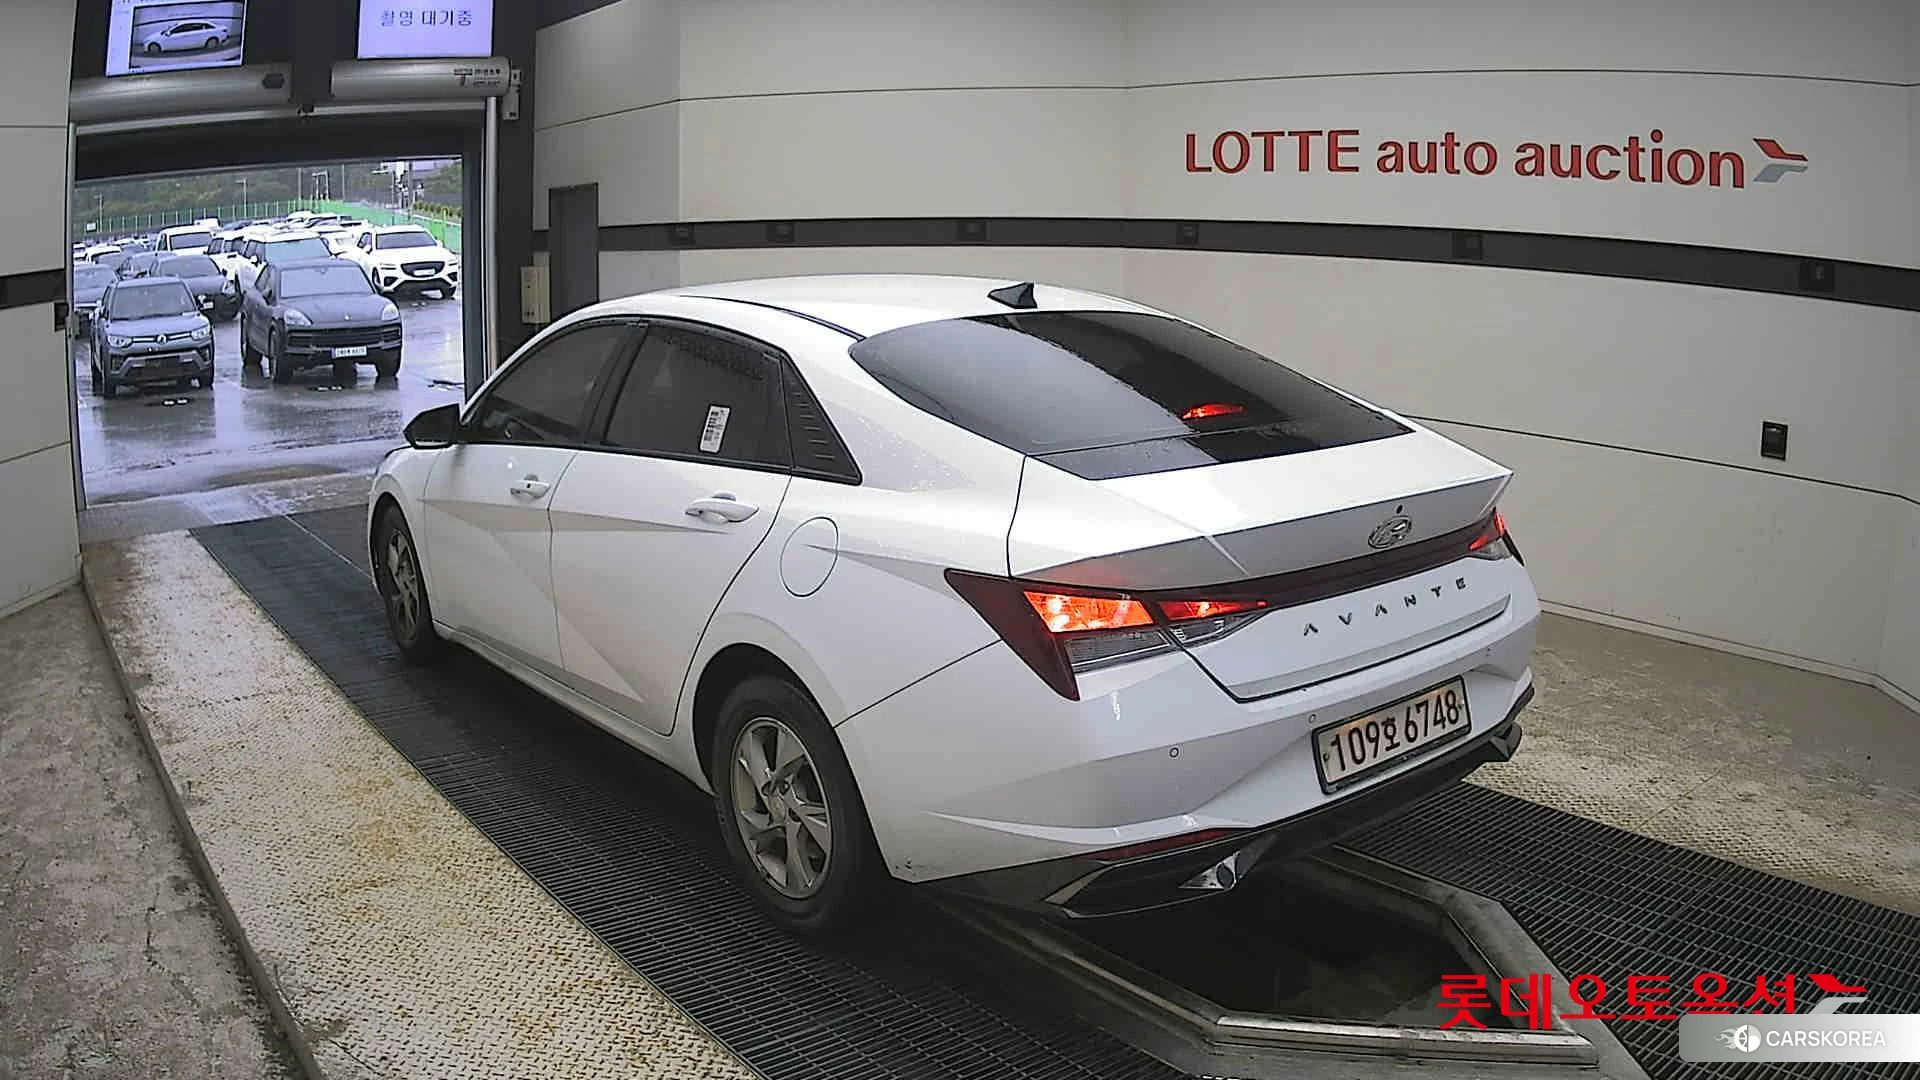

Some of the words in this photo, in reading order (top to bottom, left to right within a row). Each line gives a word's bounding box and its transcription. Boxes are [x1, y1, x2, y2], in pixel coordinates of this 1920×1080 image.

[422, 9, 473, 27] 대기중
[1185, 129, 1360, 174] LOTTE
[1376, 131, 1499, 176] auto
[1514, 129, 1745, 189] auction
[1303, 576, 1467, 637] AVANTE
